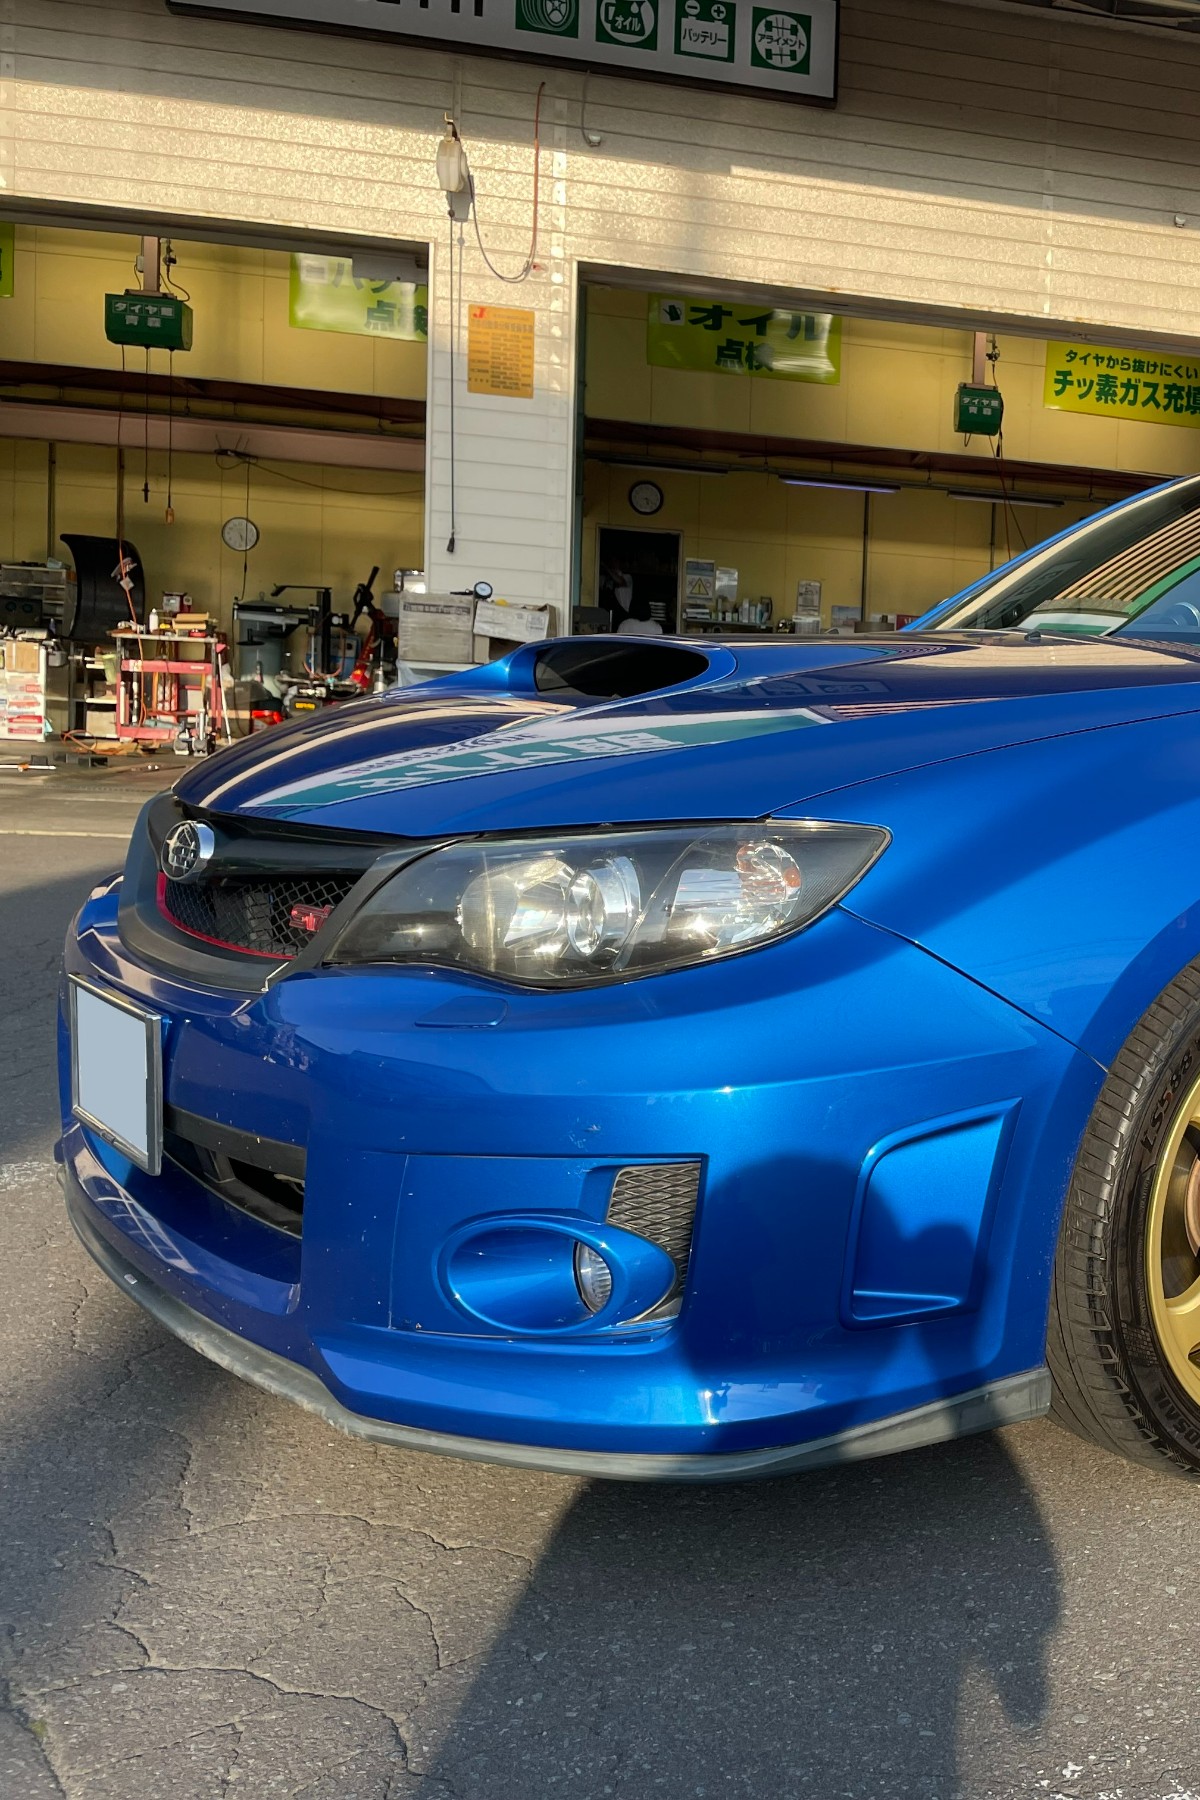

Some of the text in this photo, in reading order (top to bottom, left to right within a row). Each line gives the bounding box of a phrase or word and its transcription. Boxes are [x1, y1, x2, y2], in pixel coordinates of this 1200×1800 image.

[614, 15, 641, 32] オイル
[682, 28, 727, 46] バッテリー
[758, 33, 805, 49] アライメント
[688, 304, 827, 341] オイル
[1064, 349, 1199, 380] タイヤから抜けにくい
[1140, 1049, 1193, 1153] LS588
